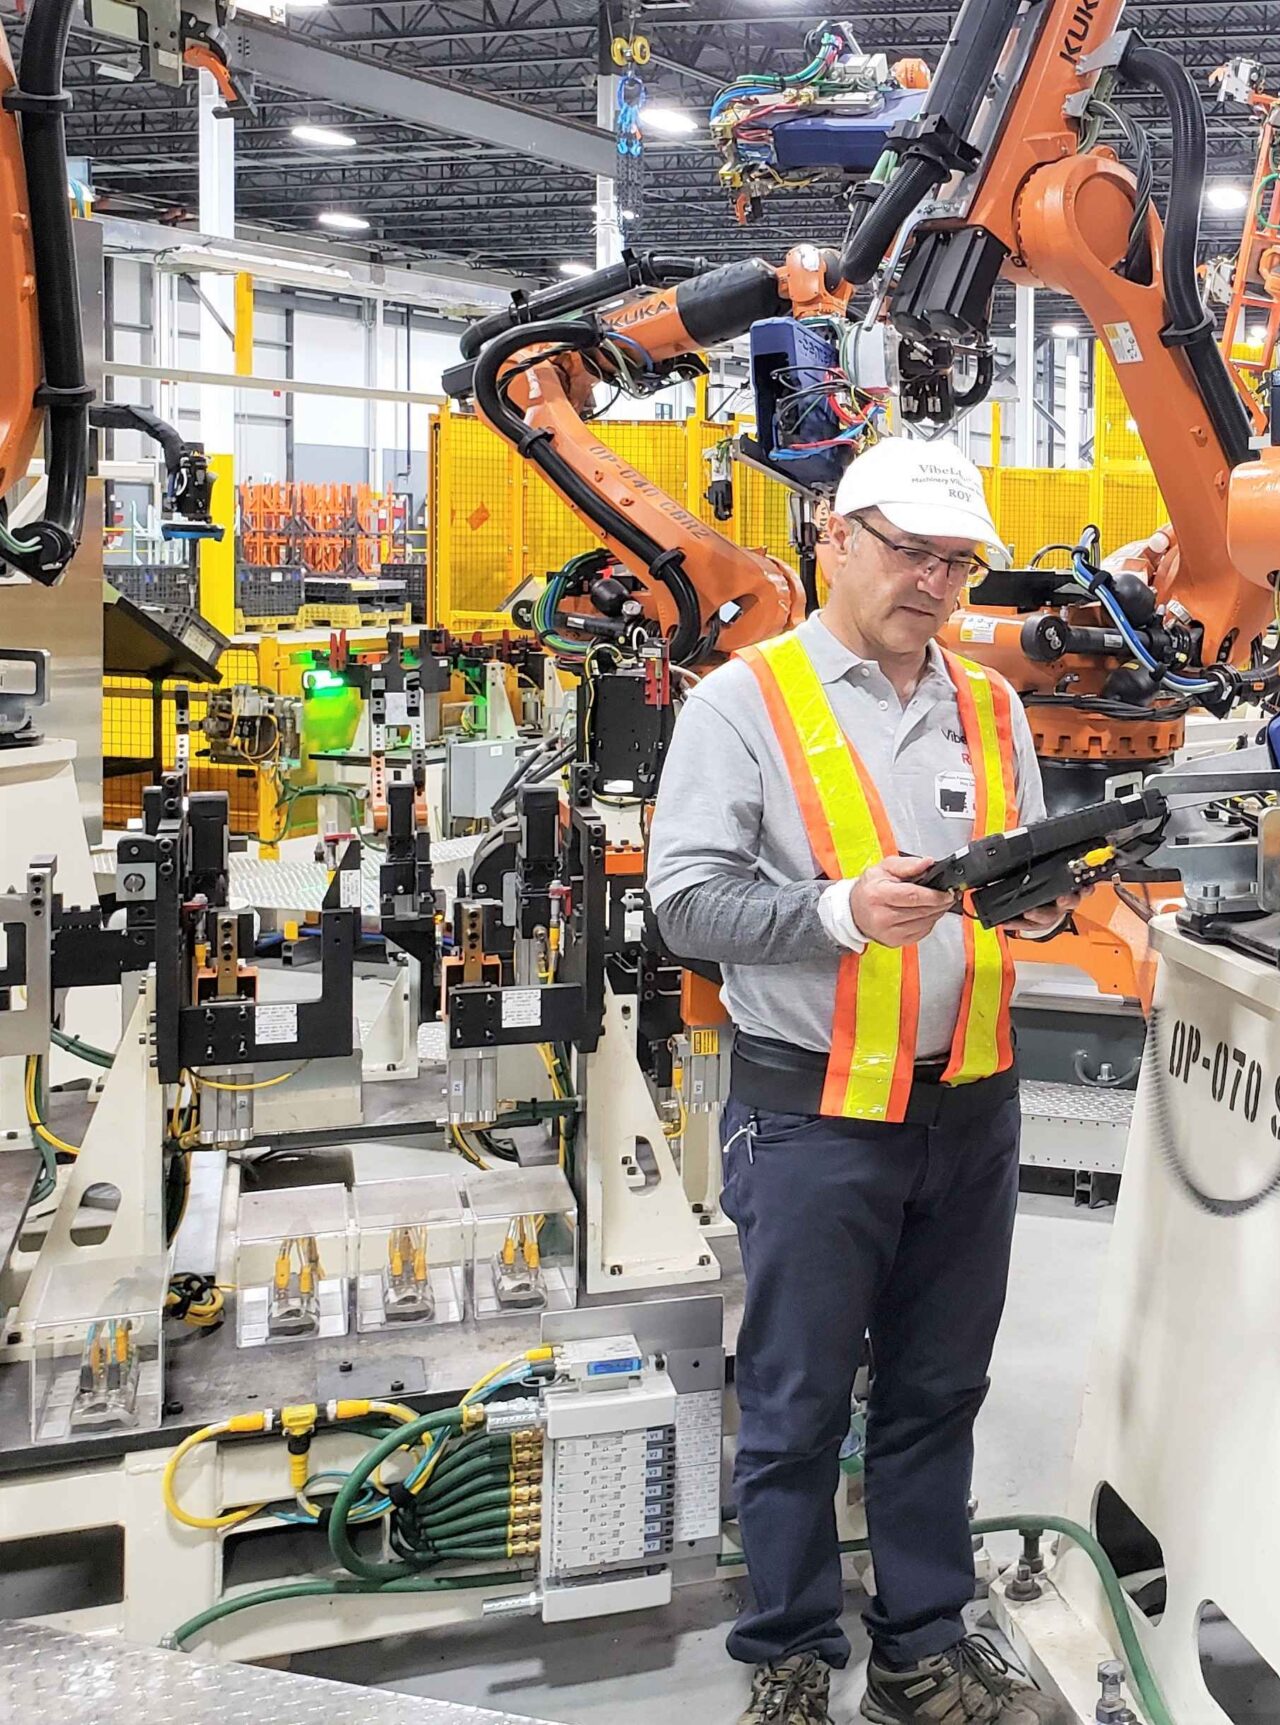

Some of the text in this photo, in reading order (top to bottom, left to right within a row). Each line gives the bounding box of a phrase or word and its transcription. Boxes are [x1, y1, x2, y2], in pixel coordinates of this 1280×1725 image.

[610, 301, 670, 328] KUKA
[948, 488, 971, 502] ROY
[941, 728, 968, 745] Vibe
[1169, 1020, 1262, 1123] OP-070
